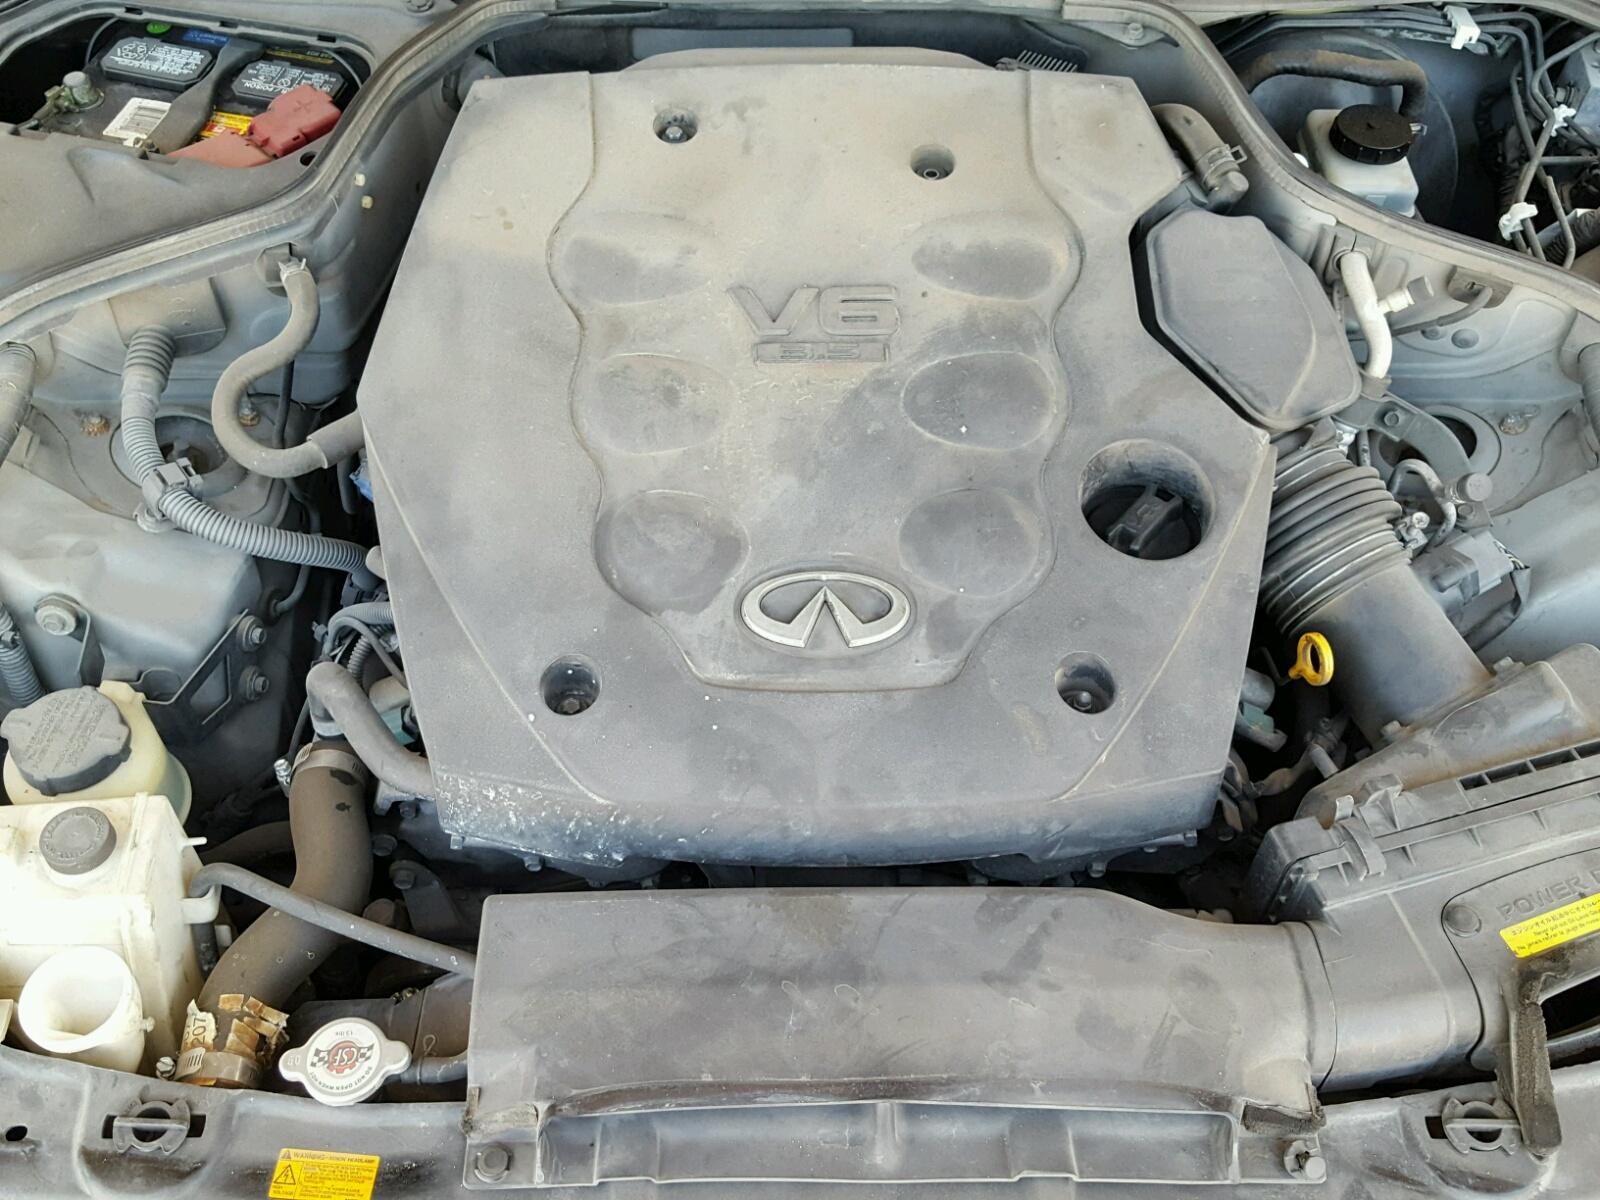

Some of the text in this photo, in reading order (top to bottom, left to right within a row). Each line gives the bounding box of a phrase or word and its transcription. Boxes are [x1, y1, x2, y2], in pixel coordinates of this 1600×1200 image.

[726, 285, 899, 337] V6
[1496, 875, 1589, 921] POWER
[333, 1047, 358, 1067] CSF
[336, 1083, 354, 1092] OPEN
